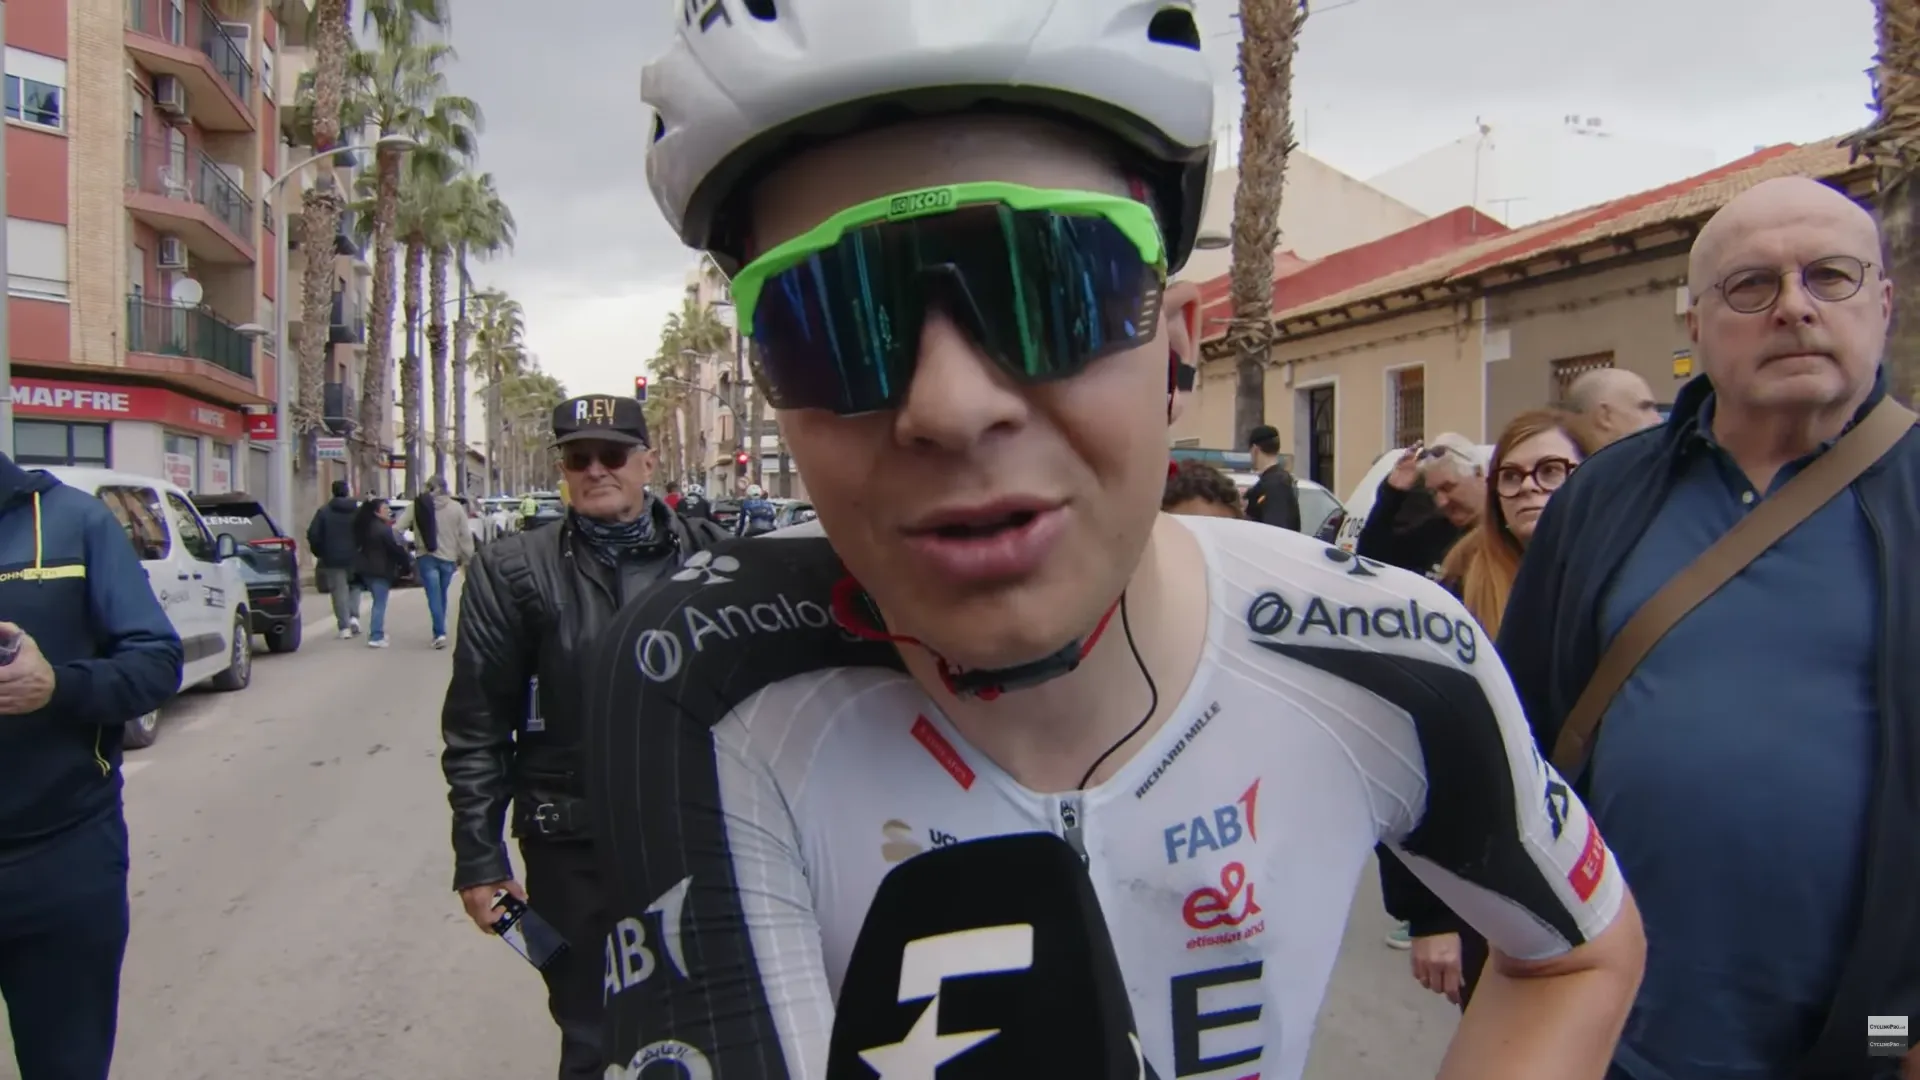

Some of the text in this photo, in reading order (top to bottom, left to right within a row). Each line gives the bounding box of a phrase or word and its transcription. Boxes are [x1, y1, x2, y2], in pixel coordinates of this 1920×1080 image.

[9, 385, 130, 412] MAPFRE
[1297, 597, 1477, 664] Analog
[1135, 701, 1221, 799] RICHARD MILLE
[604, 917, 656, 1008] AB
